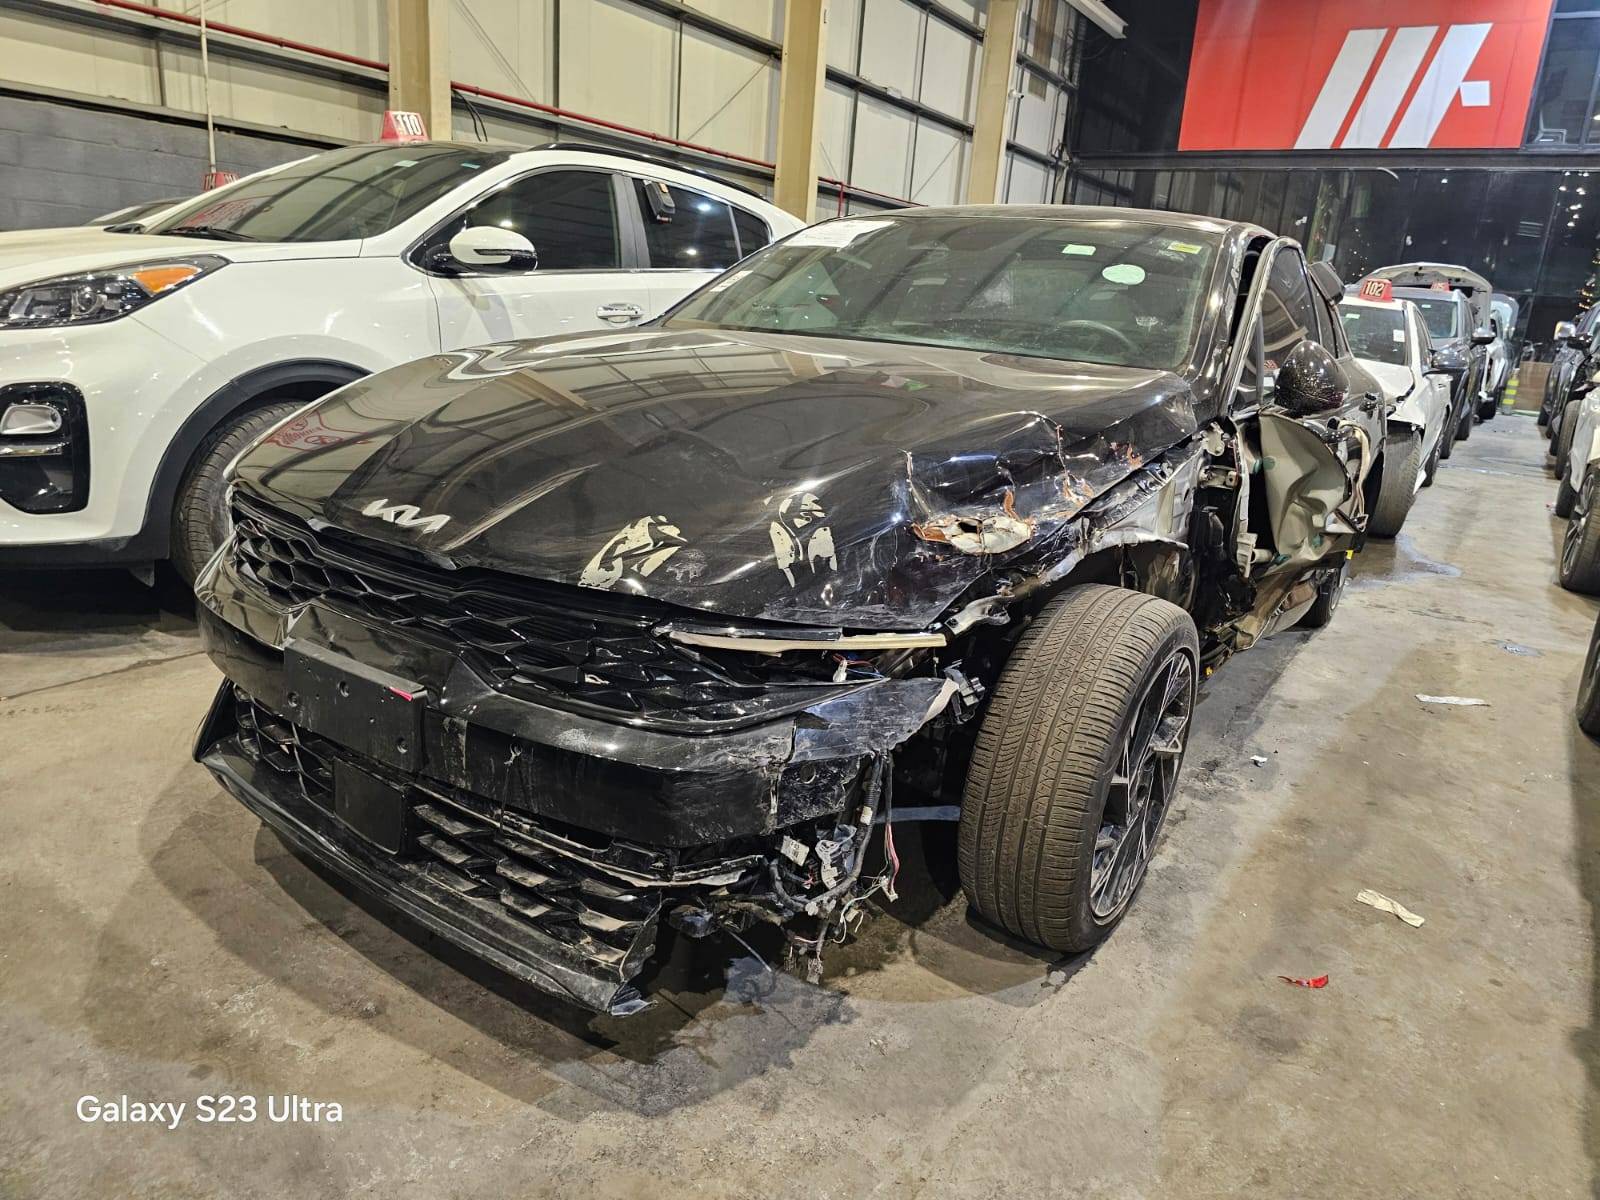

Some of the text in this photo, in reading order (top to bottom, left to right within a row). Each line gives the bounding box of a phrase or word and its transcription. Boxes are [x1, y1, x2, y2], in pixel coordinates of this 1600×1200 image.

[395, 114, 424, 136] 110
[1364, 281, 1385, 297] 102
[362, 499, 451, 534] KIA
